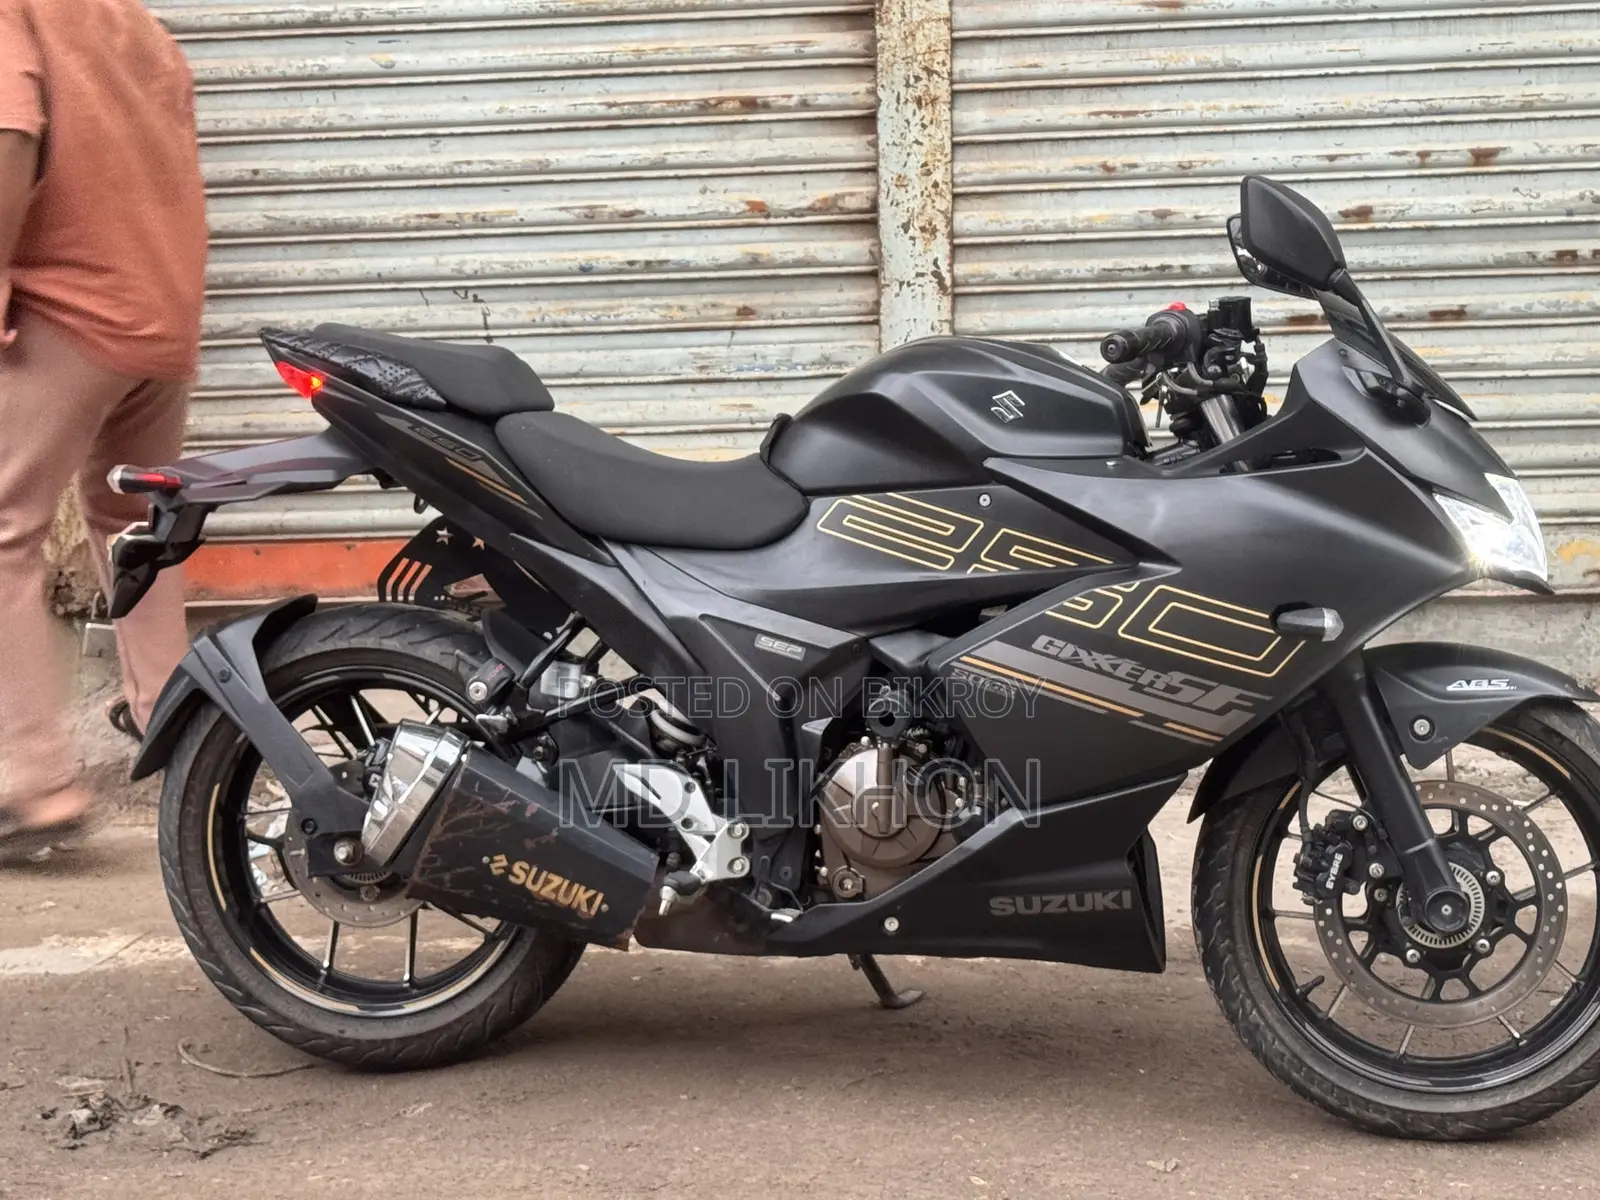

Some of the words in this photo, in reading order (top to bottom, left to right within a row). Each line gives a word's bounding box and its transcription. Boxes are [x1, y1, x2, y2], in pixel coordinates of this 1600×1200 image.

[758, 635, 803, 655] SEP
[1031, 634, 1172, 692] GIXXER
[1446, 678, 1511, 692] ABS
[508, 861, 605, 917] SUZUKI
[989, 889, 1133, 916] SUZUKI
